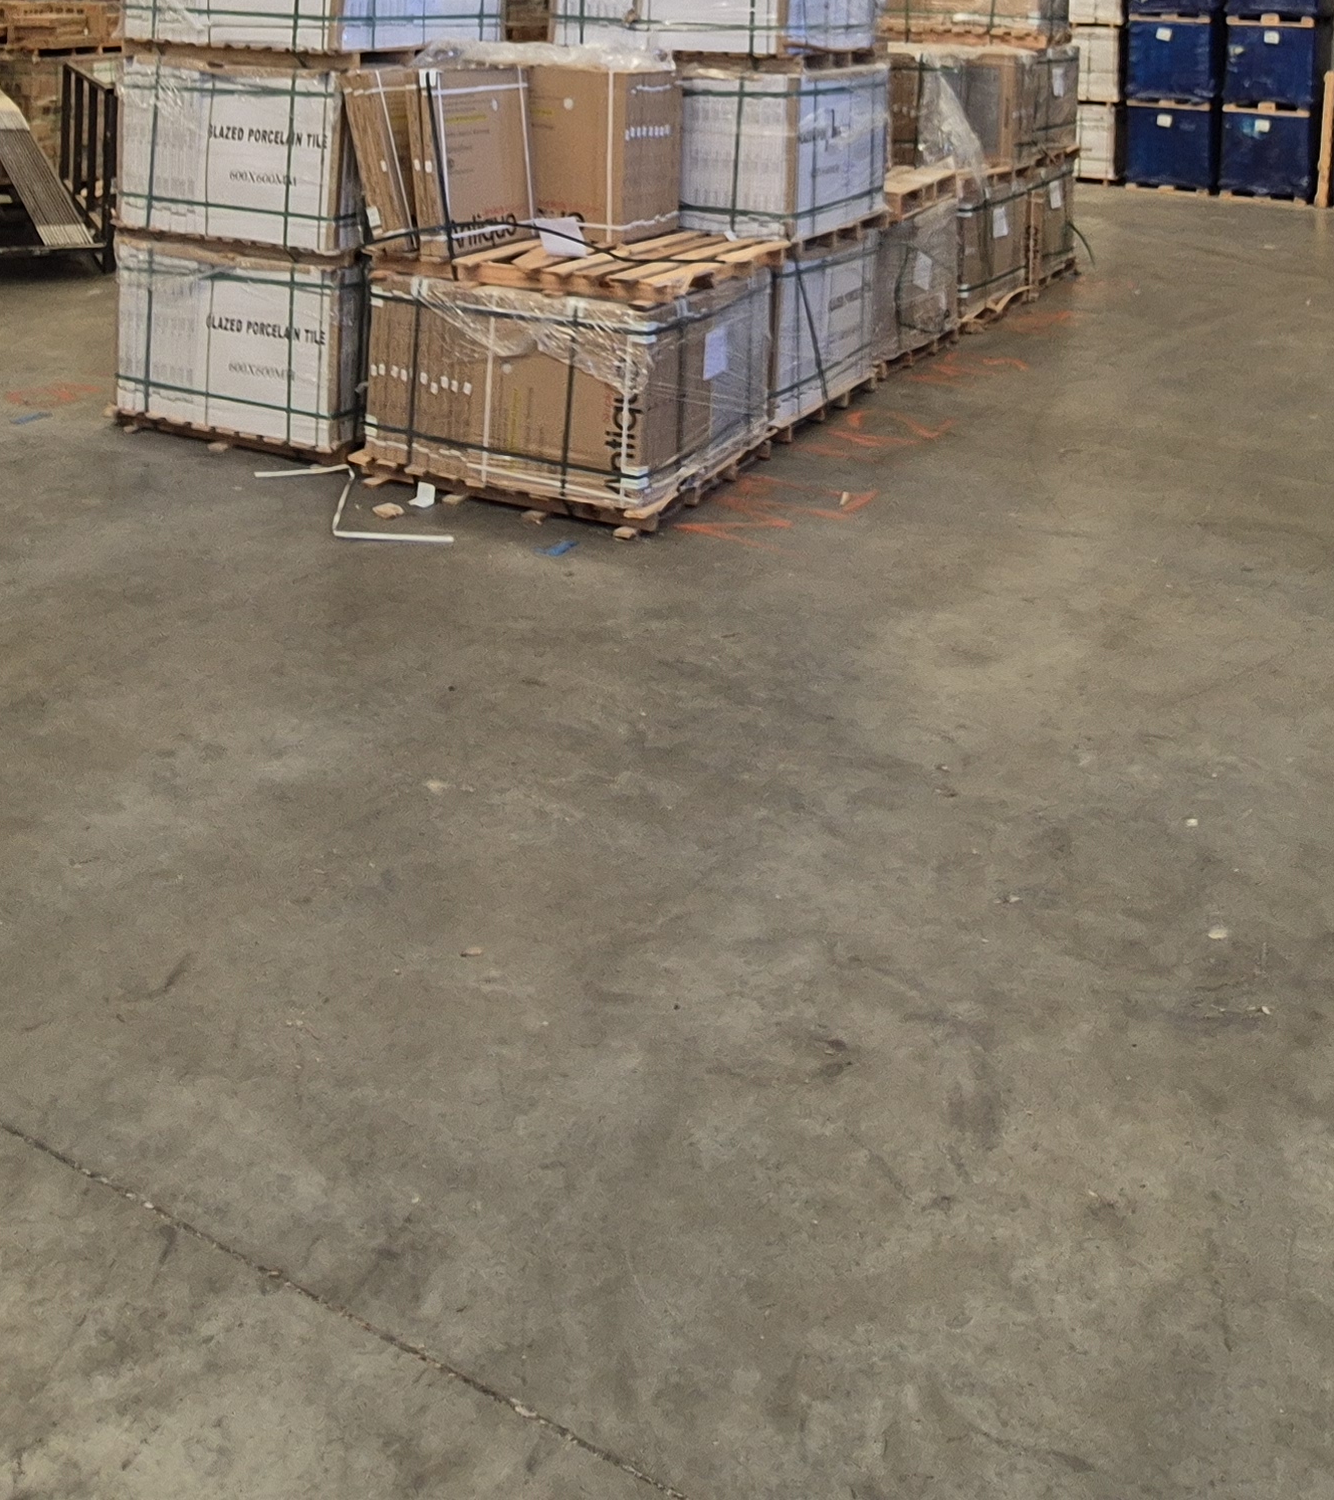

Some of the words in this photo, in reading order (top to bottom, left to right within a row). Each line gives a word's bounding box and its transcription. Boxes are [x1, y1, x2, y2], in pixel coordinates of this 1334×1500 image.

[208, 123, 244, 141] GLAZED
[306, 133, 328, 150] TILE
[304, 328, 327, 346] TILE
